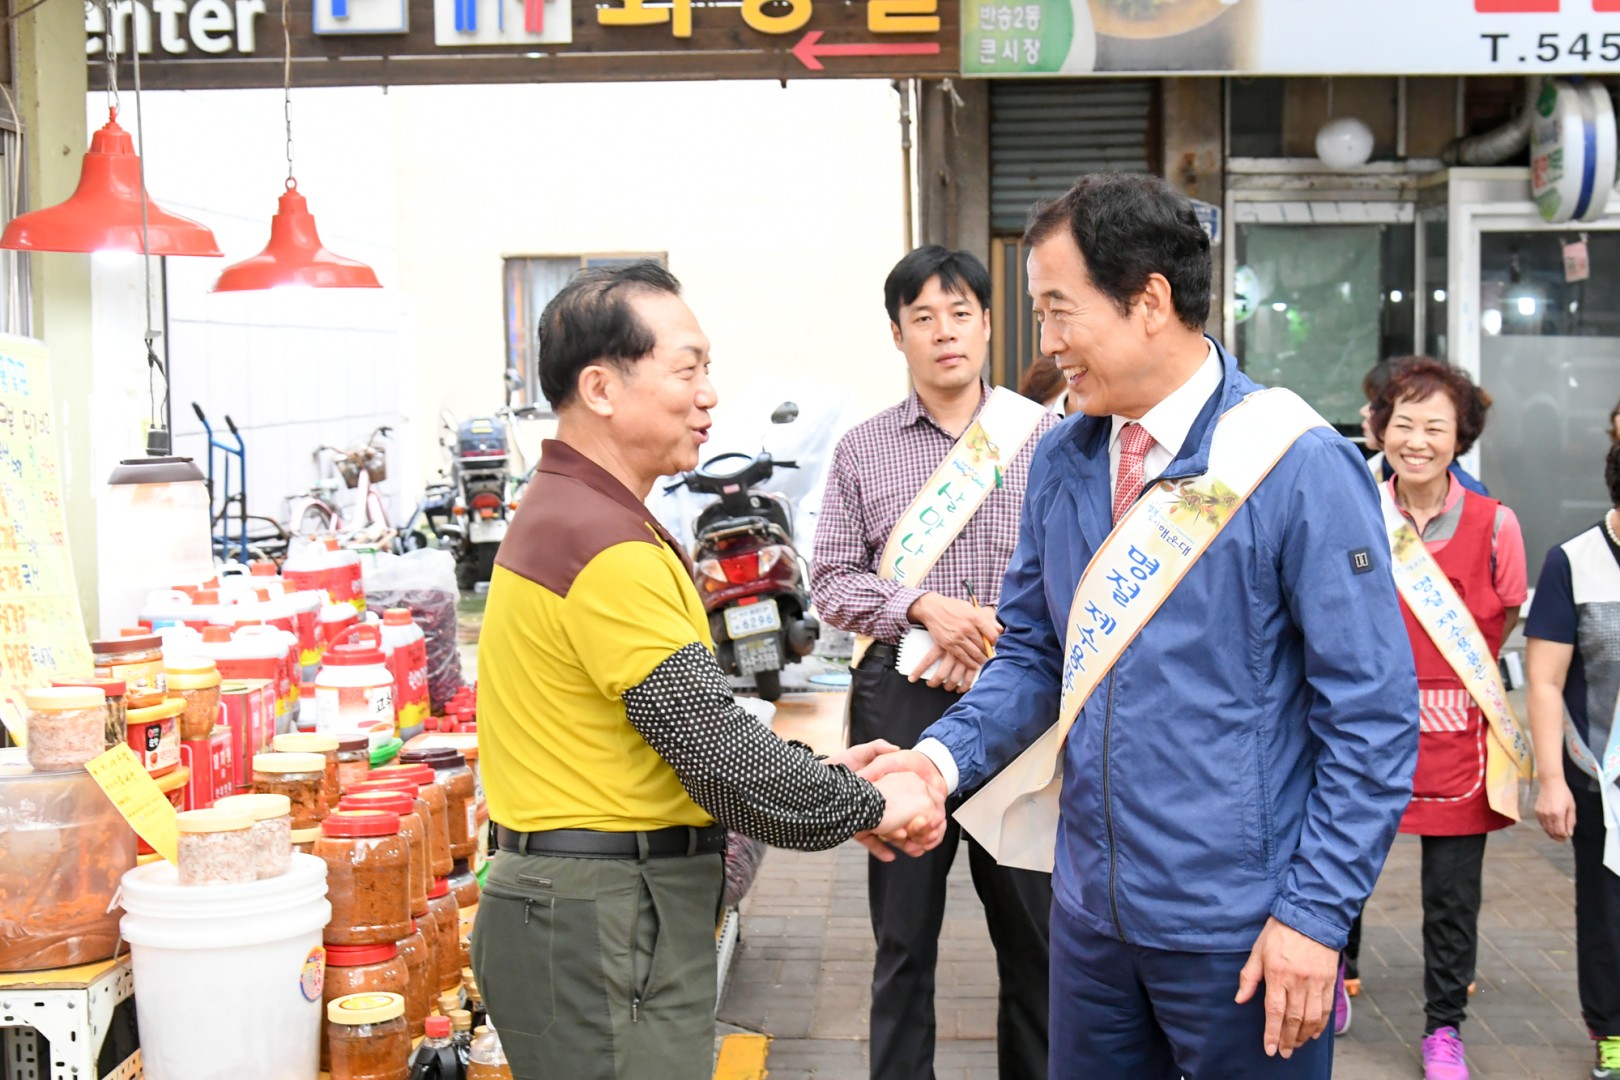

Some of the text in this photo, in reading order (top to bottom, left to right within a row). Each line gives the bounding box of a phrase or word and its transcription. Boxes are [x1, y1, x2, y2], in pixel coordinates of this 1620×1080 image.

[979, 4, 1041, 32] 반송2동
[1480, 32, 1620, 63] T.545
[1061, 544, 1161, 710] 명절 제수용품
[1412, 575, 1445, 607] 명절
[1435, 609, 1488, 681] 제수용품은
